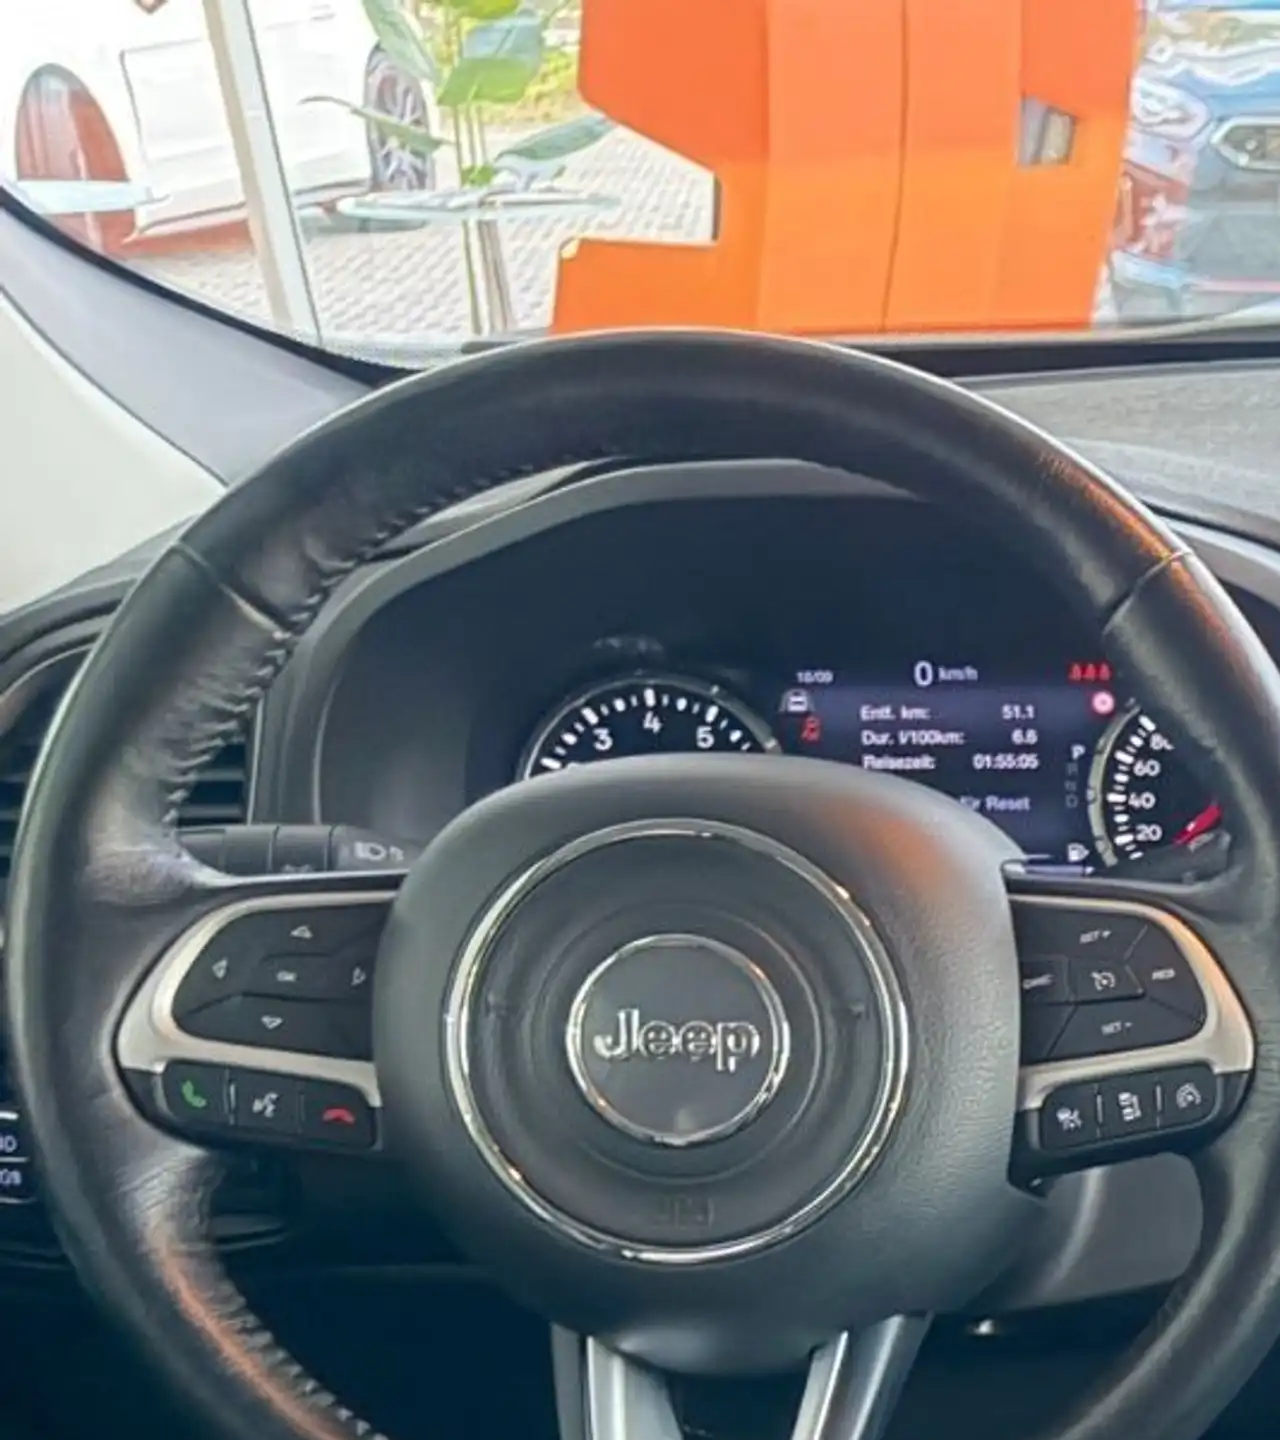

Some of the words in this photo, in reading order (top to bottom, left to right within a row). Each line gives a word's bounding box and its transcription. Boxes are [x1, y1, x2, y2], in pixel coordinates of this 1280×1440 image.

[914, 660, 933, 687] 0
[642, 711, 662, 734] 4
[1002, 704, 1035, 720] 51.1
[593, 728, 613, 751] 3
[696, 726, 715, 749] 5
[1133, 759, 1161, 777] 60
[1128, 792, 1156, 809] 40
[1135, 824, 1163, 841] 20
[593, 1008, 761, 1073] Jeep
